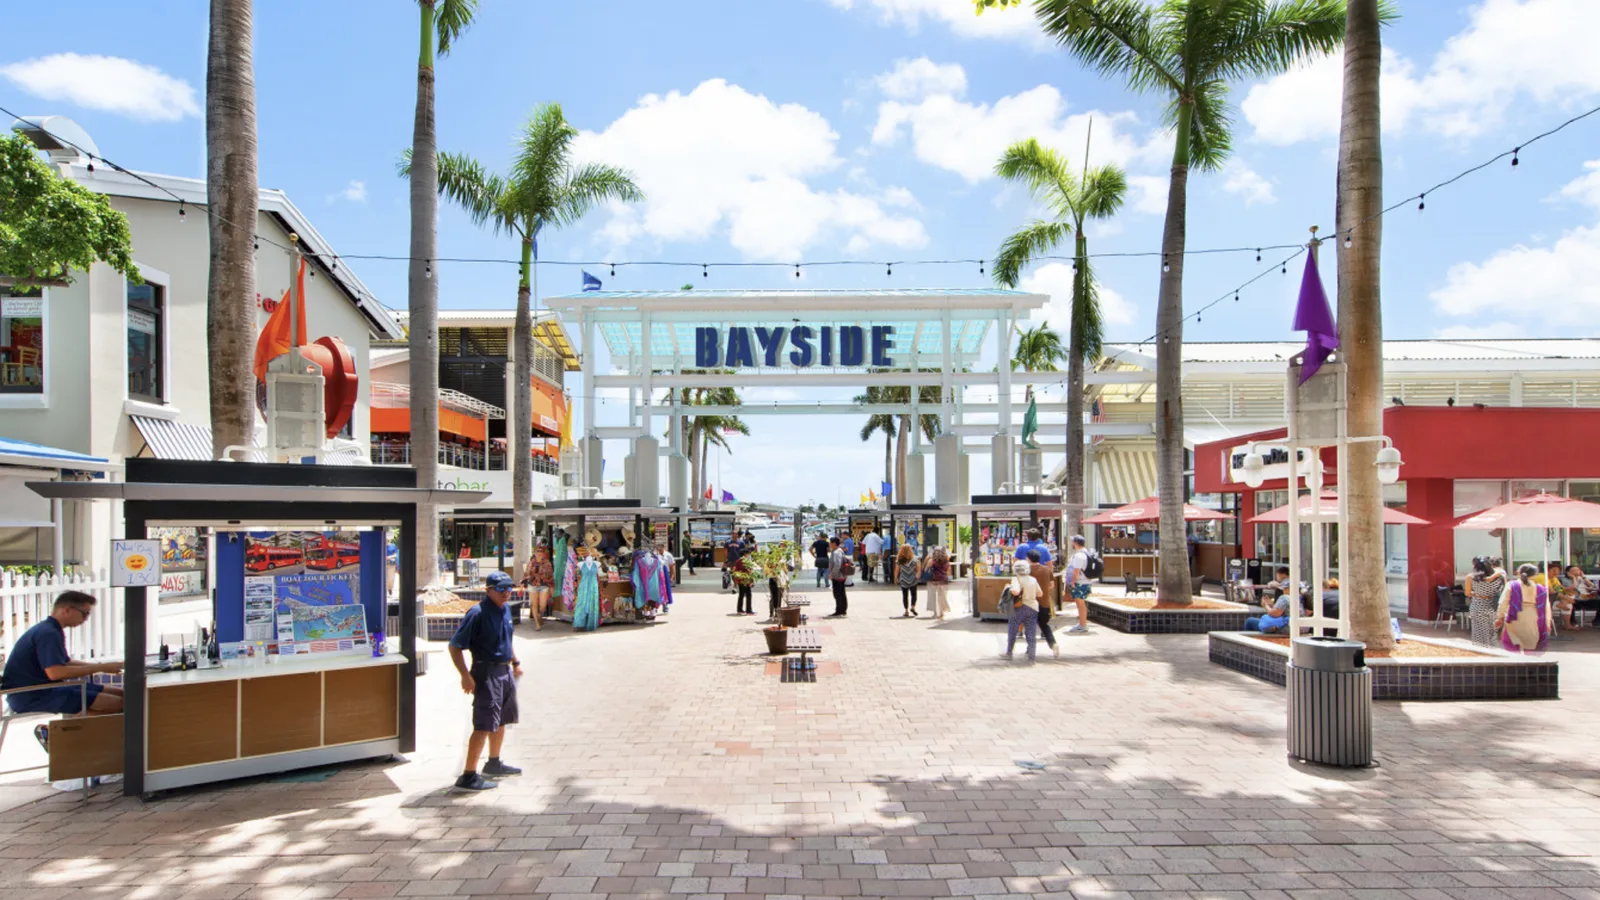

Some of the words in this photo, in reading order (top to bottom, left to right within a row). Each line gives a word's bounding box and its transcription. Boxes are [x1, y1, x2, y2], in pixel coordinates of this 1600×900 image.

[695, 325, 895, 368] BAYSIDE
[437, 477, 489, 490] tobar
[160, 575, 185, 592] WAYS
[326, 573, 359, 581] TICKETS
